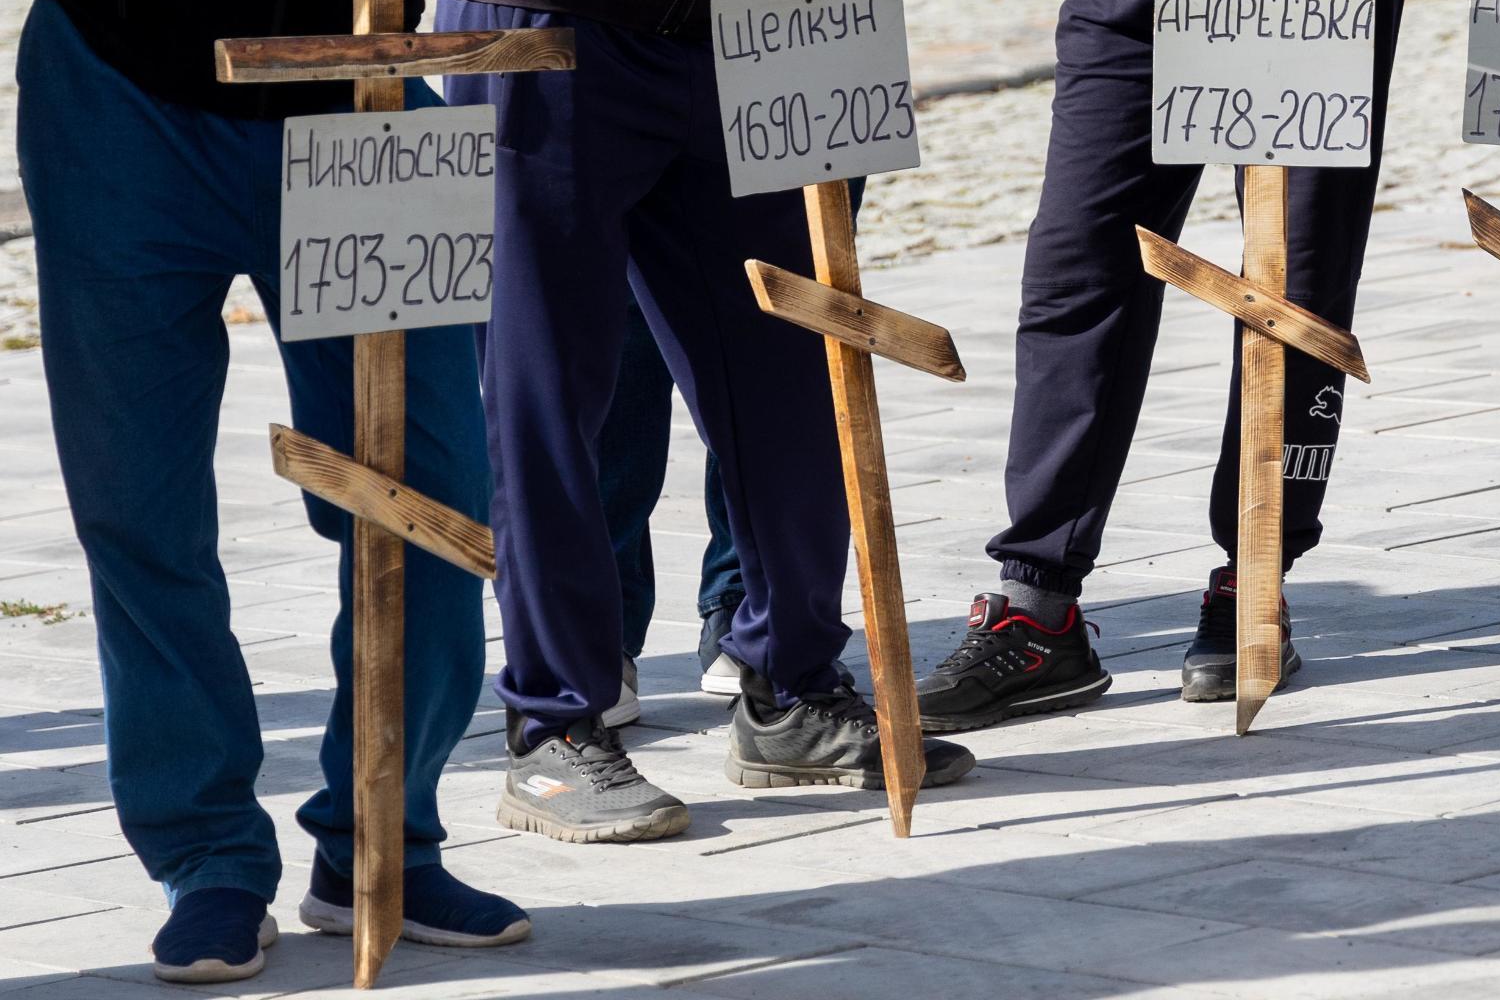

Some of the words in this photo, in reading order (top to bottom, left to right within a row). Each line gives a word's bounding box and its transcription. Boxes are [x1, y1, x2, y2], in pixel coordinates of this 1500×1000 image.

[728, 81, 915, 162] 1690-2023
[1156, 86, 1371, 150] 1778-2023
[284, 233, 494, 315] 1793-2023
